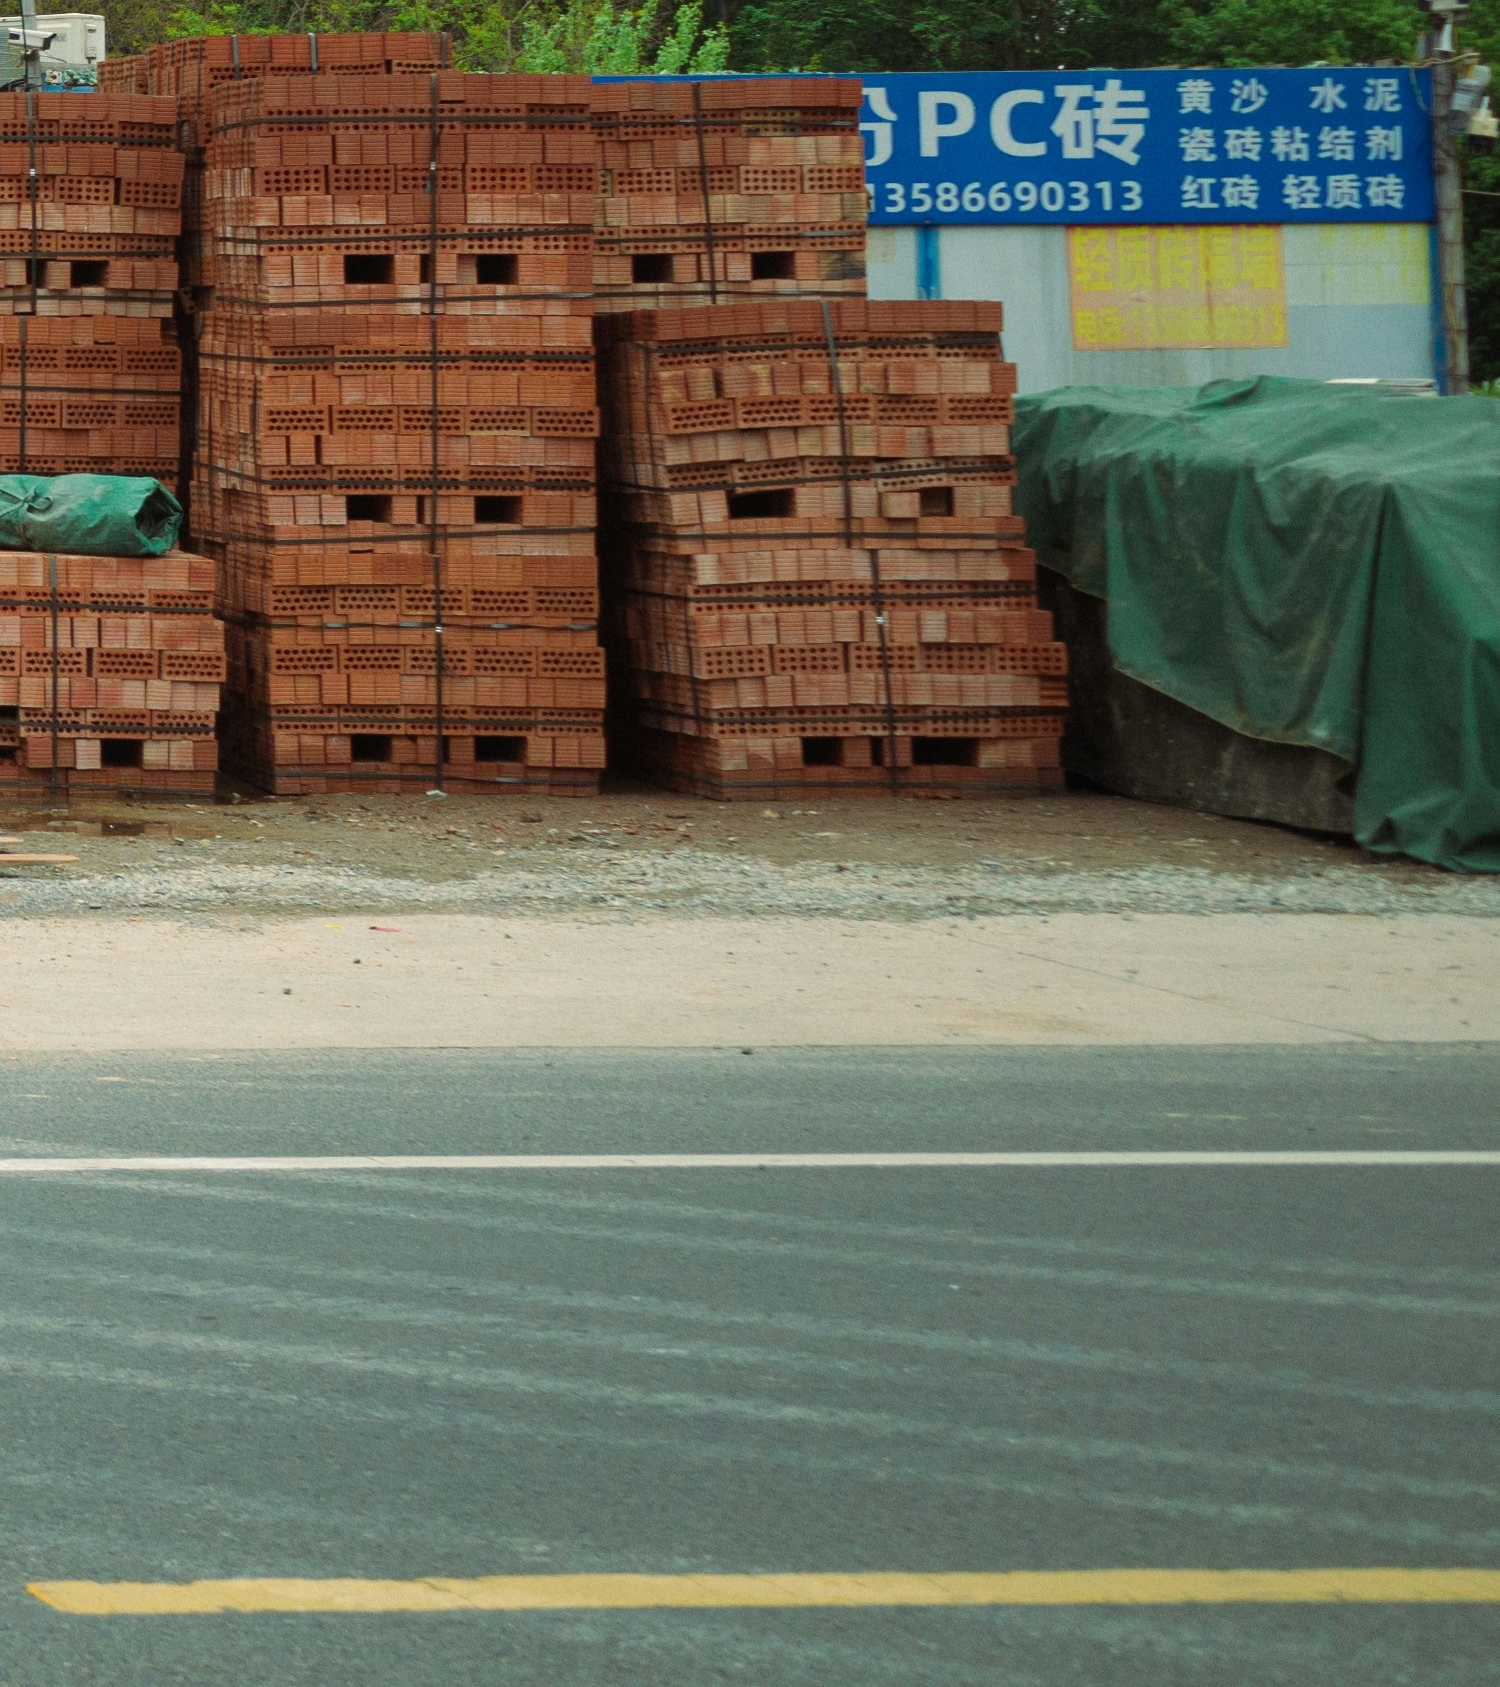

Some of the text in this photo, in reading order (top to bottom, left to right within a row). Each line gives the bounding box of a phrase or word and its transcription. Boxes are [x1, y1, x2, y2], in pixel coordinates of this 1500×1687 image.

[1176, 78, 1403, 114] 黄沙 水泥
[1178, 126, 1404, 162] 瓷砖粘结剂
[1180, 173, 1405, 210] 红砖 轻质砖
